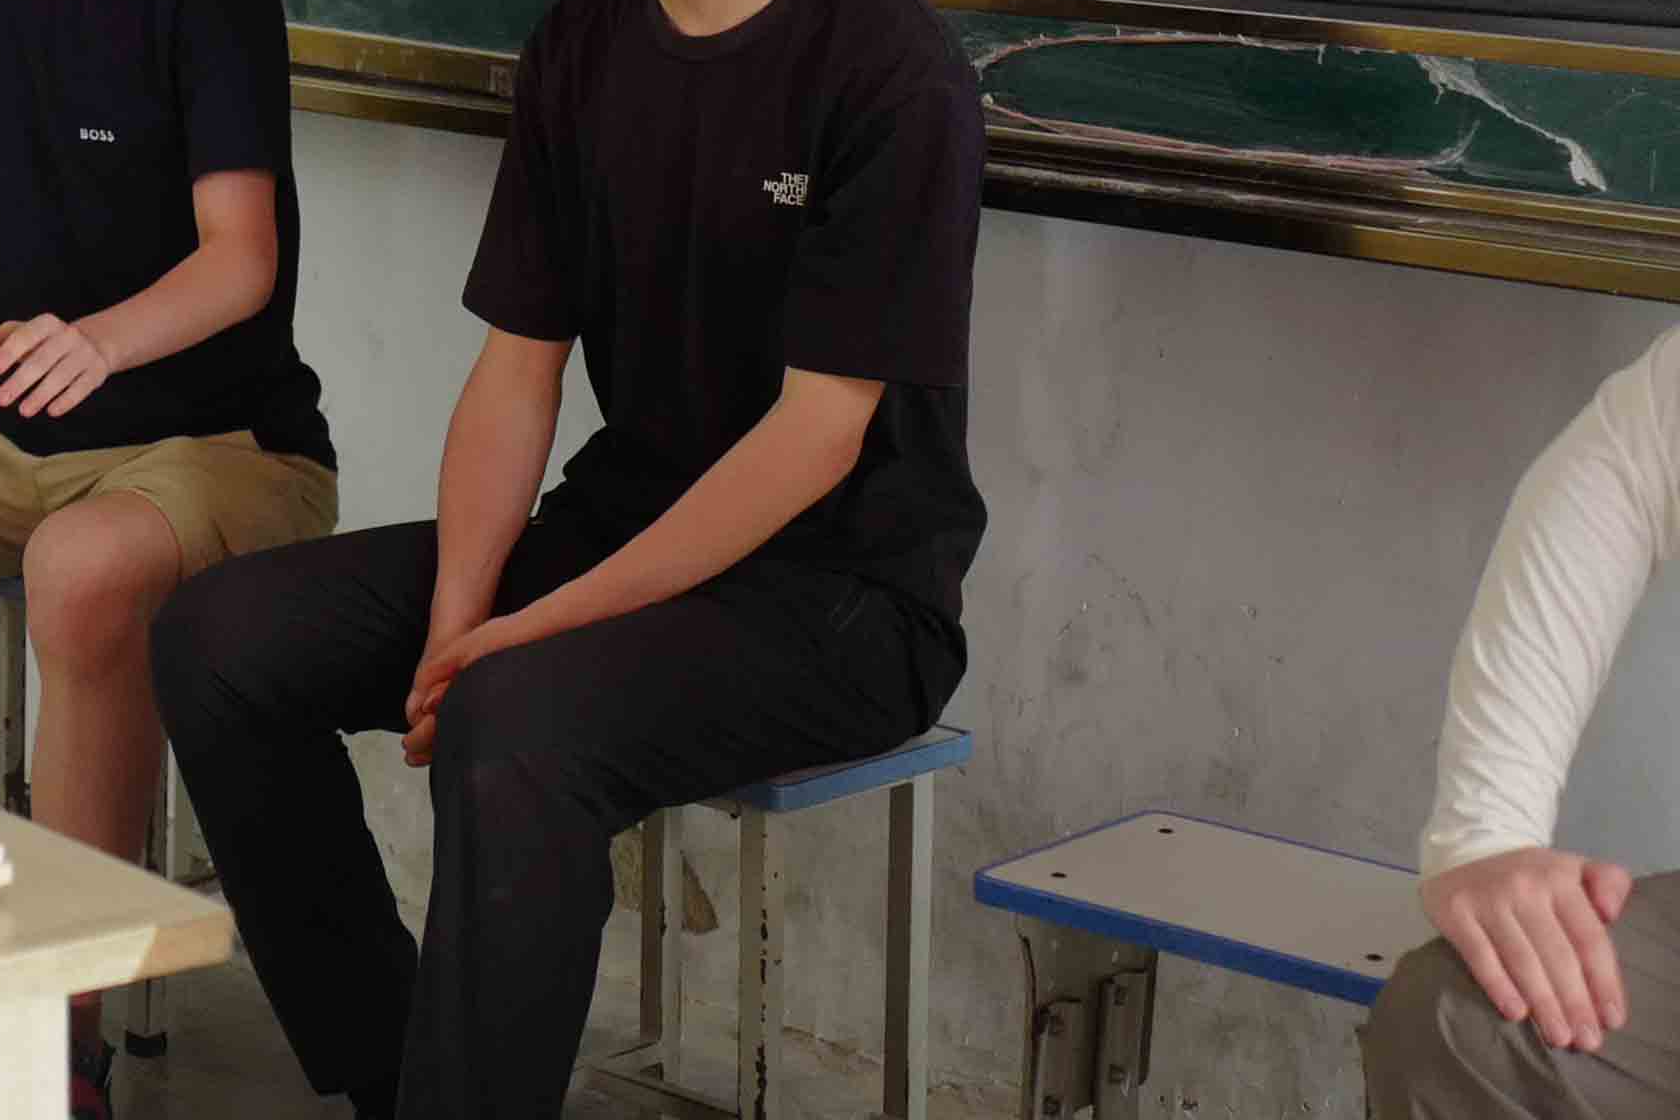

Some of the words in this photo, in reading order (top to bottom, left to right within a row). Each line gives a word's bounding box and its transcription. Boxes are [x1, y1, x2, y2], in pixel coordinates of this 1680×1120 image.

[79, 127, 115, 143] BOSS
[780, 172, 804, 185] THE
[763, 179, 805, 195] NORTH
[773, 192, 805, 206] FACE
